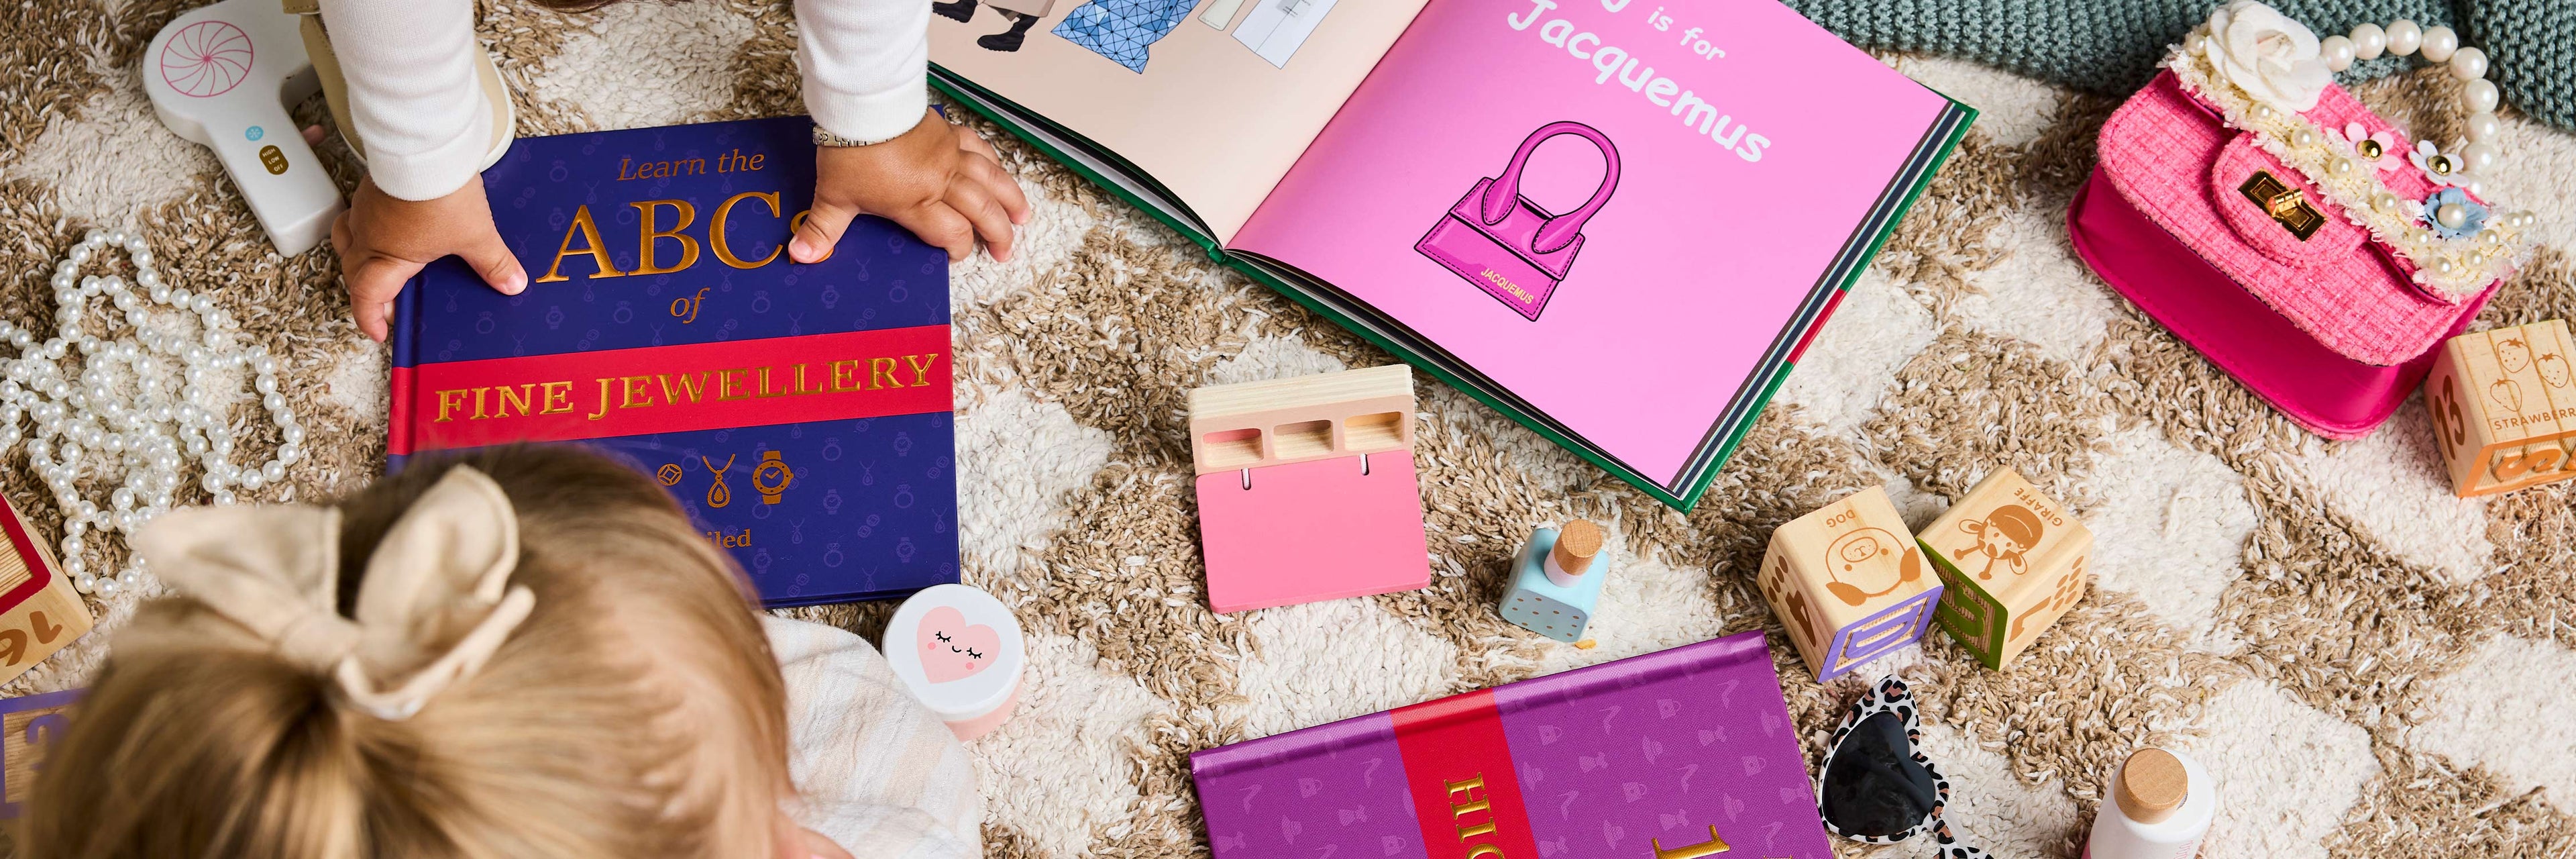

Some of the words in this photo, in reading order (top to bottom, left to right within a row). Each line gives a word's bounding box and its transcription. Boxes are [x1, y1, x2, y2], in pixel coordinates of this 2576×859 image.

[1647, 6, 1674, 32] is
[1679, 27, 1726, 60] for
[1507, 0, 1772, 162] Jacquemus
[262, 148, 276, 158] HIGH
[268, 156, 280, 164] LOW
[274, 164, 283, 172] OFF
[616, 157, 707, 181] Learn
[716, 148, 765, 172] the
[669, 287, 710, 324] of
[1480, 267, 1534, 305] JACQUEMUS
[433, 380, 574, 423] FINE
[588, 352, 938, 421] JEWELLERY
[2434, 374, 2465, 460] 13
[1826, 509, 1856, 527] DOG
[2014, 487, 2063, 527] GIRAFFE
[1785, 589, 1817, 648] 4
[2008, 595, 2051, 643] 7
